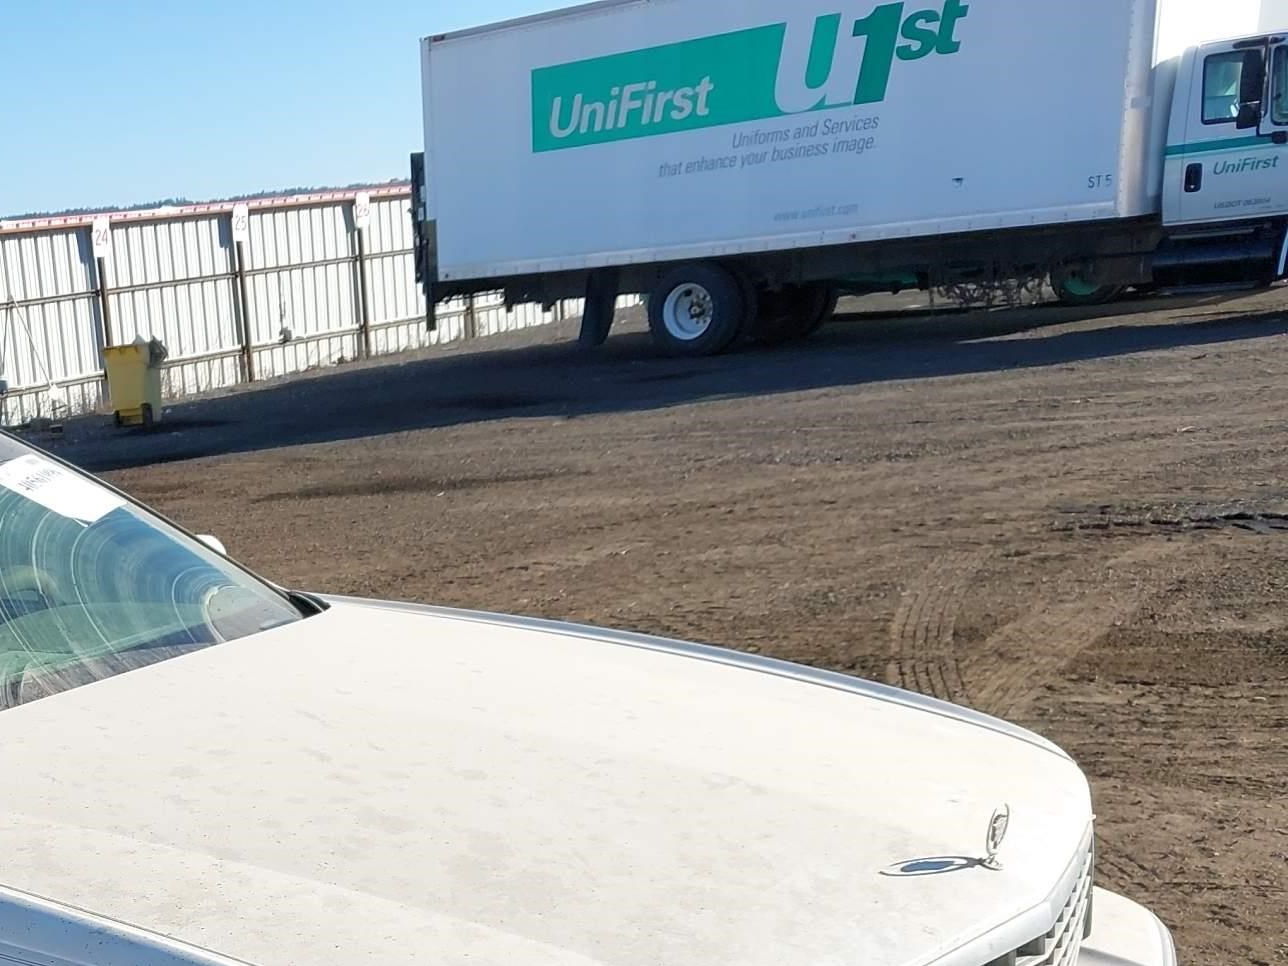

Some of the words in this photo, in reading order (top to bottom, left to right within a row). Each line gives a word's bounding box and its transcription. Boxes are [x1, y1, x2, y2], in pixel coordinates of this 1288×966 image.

[549, 75, 714, 138] UniFirst
[732, 128, 791, 149] Uniforms
[793, 119, 820, 140] and
[822, 114, 880, 136] Services
[658, 161, 683, 178] that
[685, 152, 737, 175] enhance
[740, 147, 768, 169] your
[771, 139, 828, 163] business
[1213, 155, 1280, 175] UniFirst
[1088, 175, 1103, 188] ST
[235, 214, 247, 231] 25
[95, 228, 108, 246] 24
